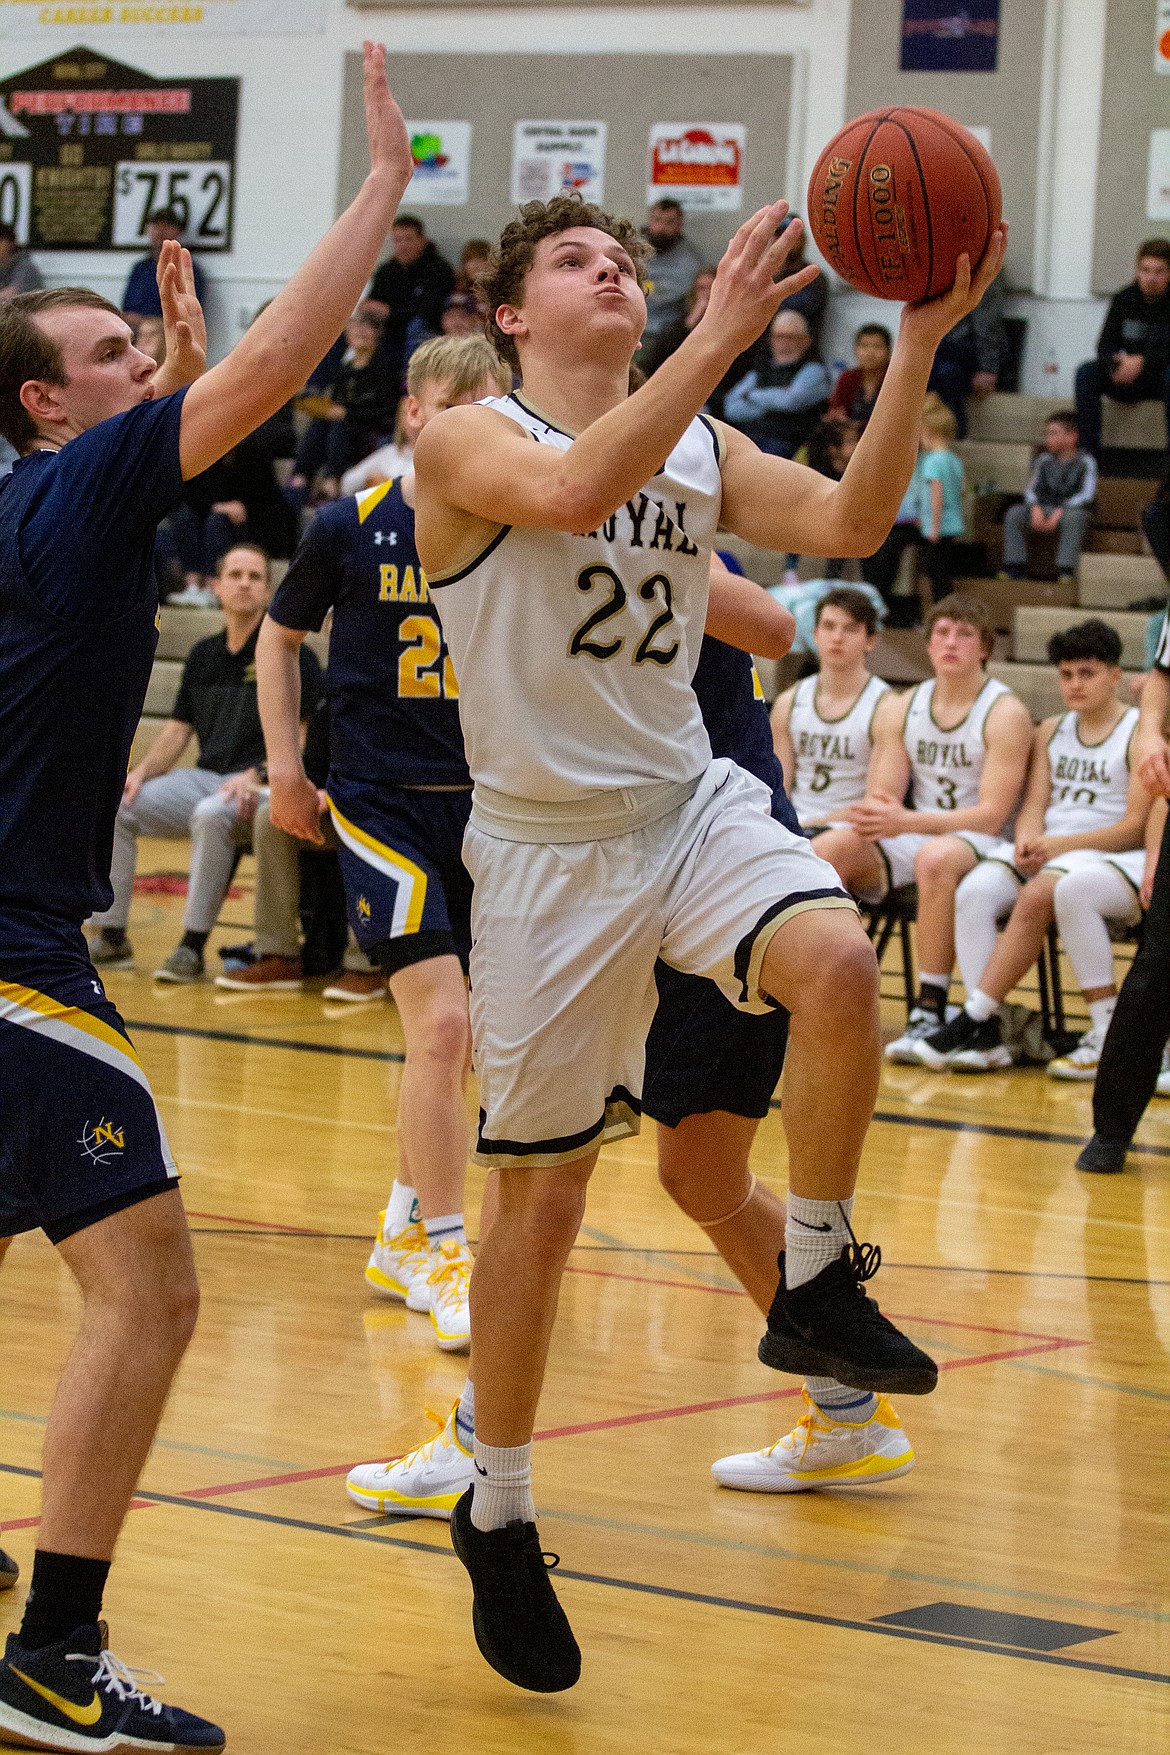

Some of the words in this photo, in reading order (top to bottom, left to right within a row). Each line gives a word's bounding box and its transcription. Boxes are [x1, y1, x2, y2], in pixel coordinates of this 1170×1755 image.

[566, 561, 682, 669] 22
[799, 730, 855, 760] ROYAL
[917, 738, 973, 768] ROYAL
[810, 762, 834, 793] 5
[1055, 755, 1111, 784] ROYAL
[936, 776, 957, 811] 3
